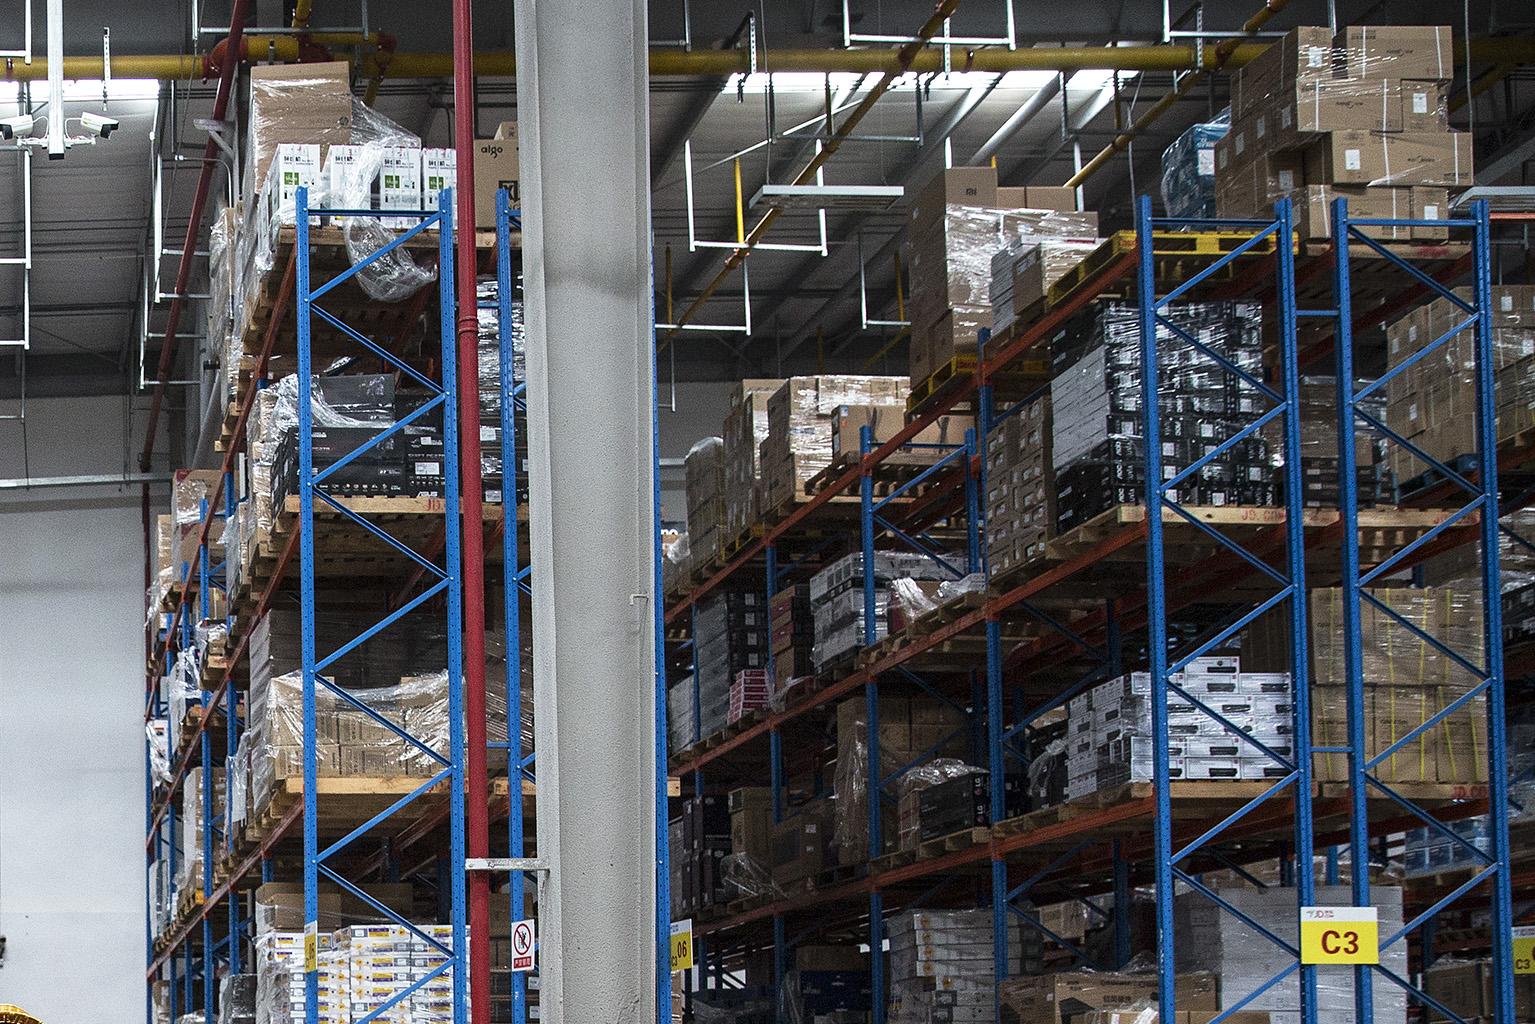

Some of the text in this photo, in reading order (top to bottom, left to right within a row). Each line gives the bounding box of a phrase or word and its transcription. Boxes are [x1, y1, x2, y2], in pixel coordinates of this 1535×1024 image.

[677, 941, 687, 958] 06
[1321, 930, 1359, 954] C3
[1515, 958, 1531, 970] C3
